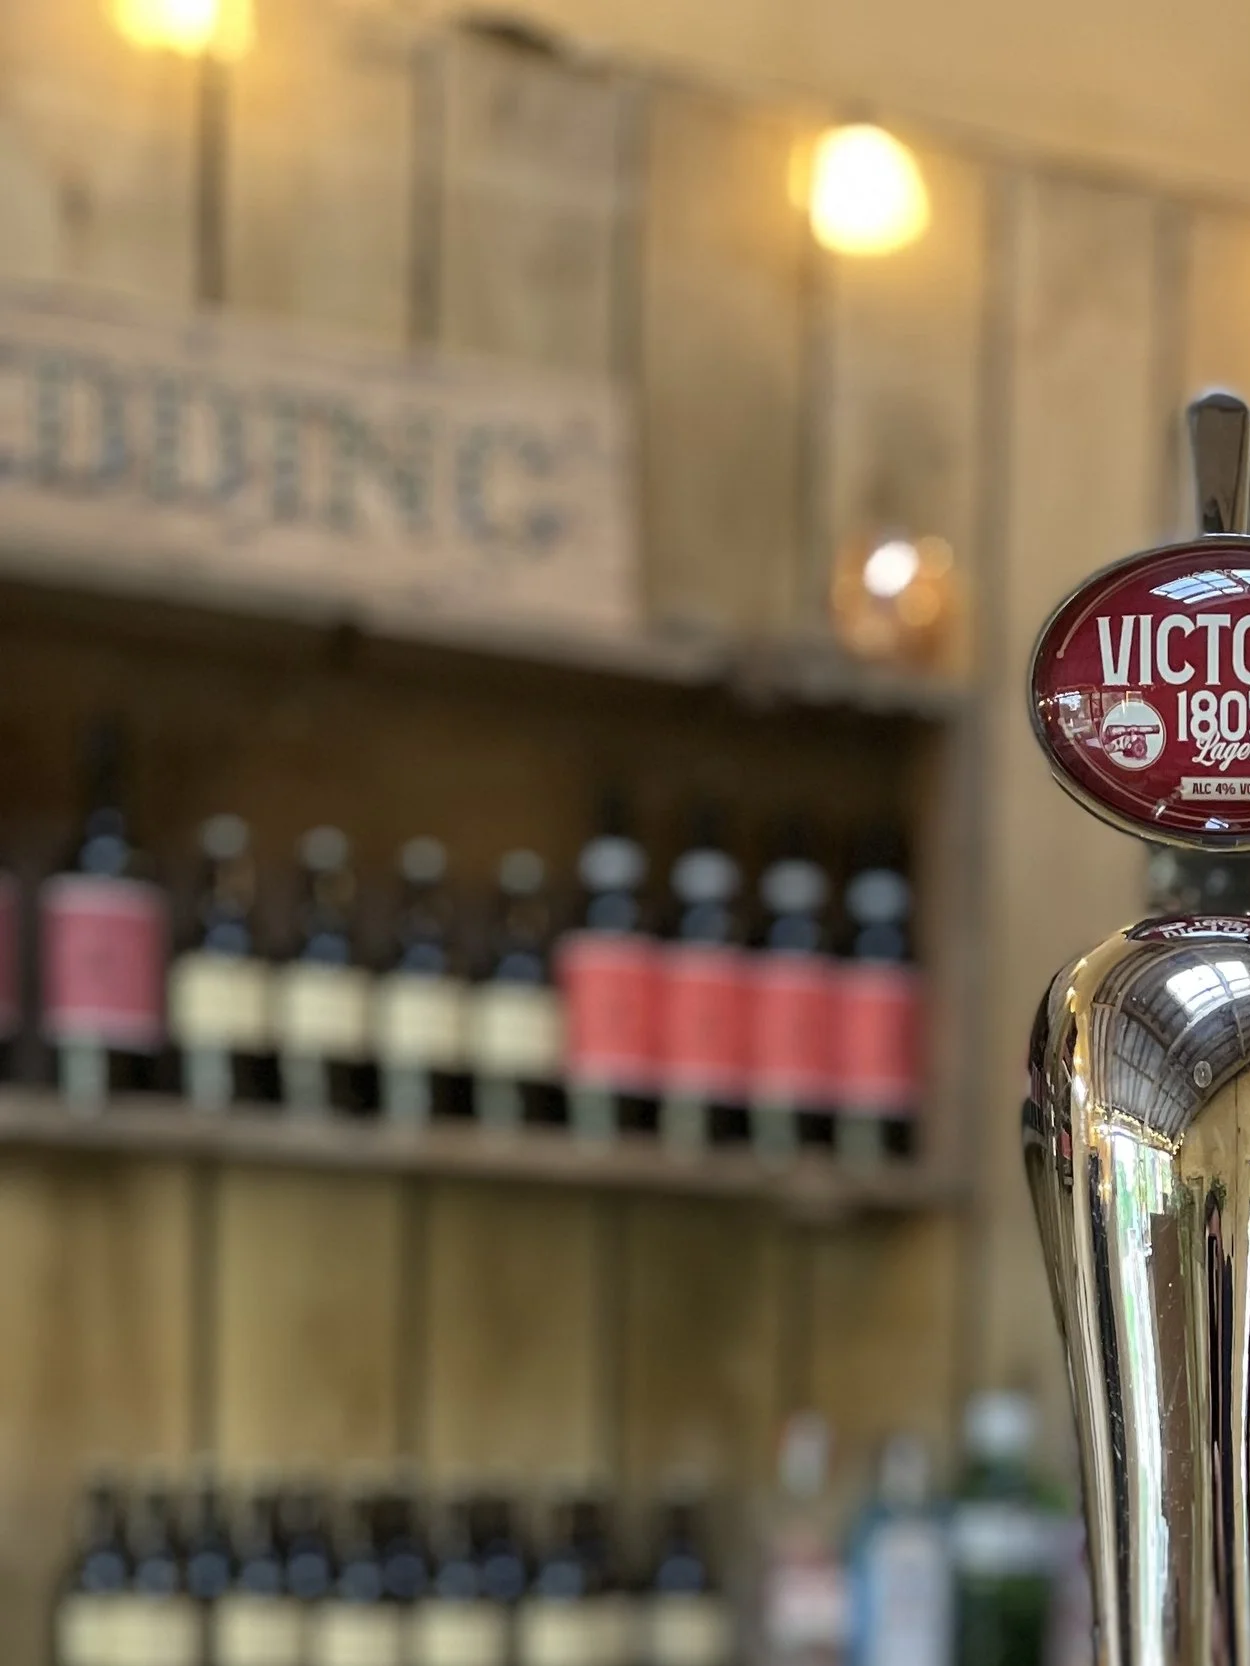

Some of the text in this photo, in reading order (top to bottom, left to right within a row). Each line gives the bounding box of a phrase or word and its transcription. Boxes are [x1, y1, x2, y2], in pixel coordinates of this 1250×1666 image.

[0, 344, 567, 552] DDING
[1192, 783, 1212, 795] ALC
[1215, 783, 1236, 795] 4%
